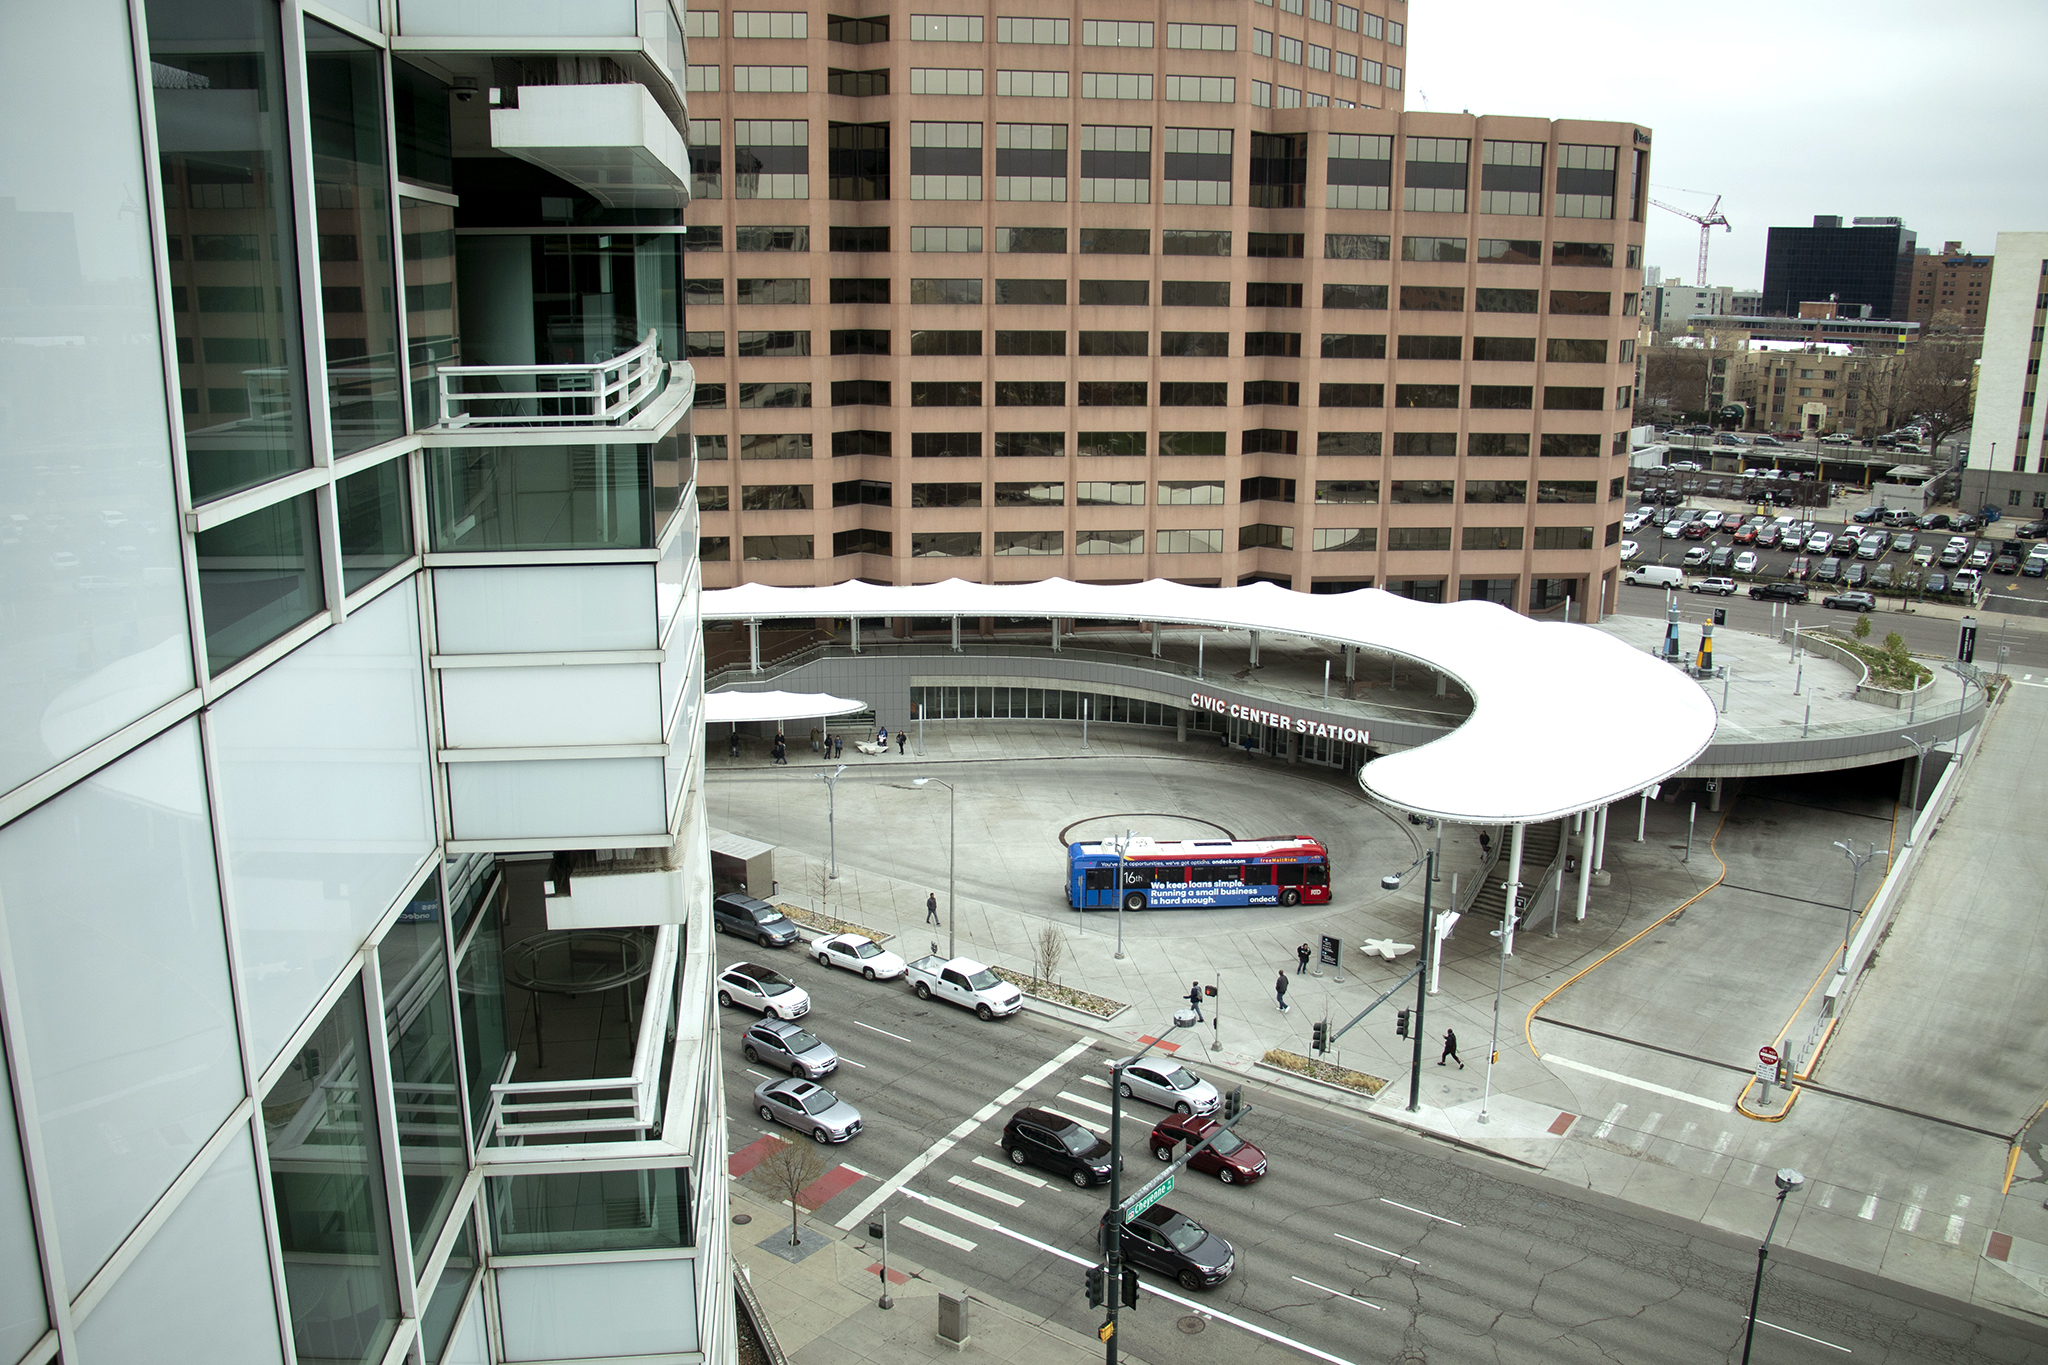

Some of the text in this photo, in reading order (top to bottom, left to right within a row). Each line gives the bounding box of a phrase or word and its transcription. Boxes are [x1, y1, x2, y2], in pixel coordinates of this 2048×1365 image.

[1191, 693, 1369, 745] CIVIC CENTER STATION
[1123, 871, 1143, 884] 16th
[1151, 879, 1245, 889] We keep loans simple.
[1151, 889, 1186, 898] Running
[1195, 887, 1219, 896] small
[1220, 887, 1258, 895] business
[1151, 896, 1216, 905] is hard enough.
[1249, 895, 1277, 903] ondeck
[1134, 1185, 1166, 1215] Cheyenne
